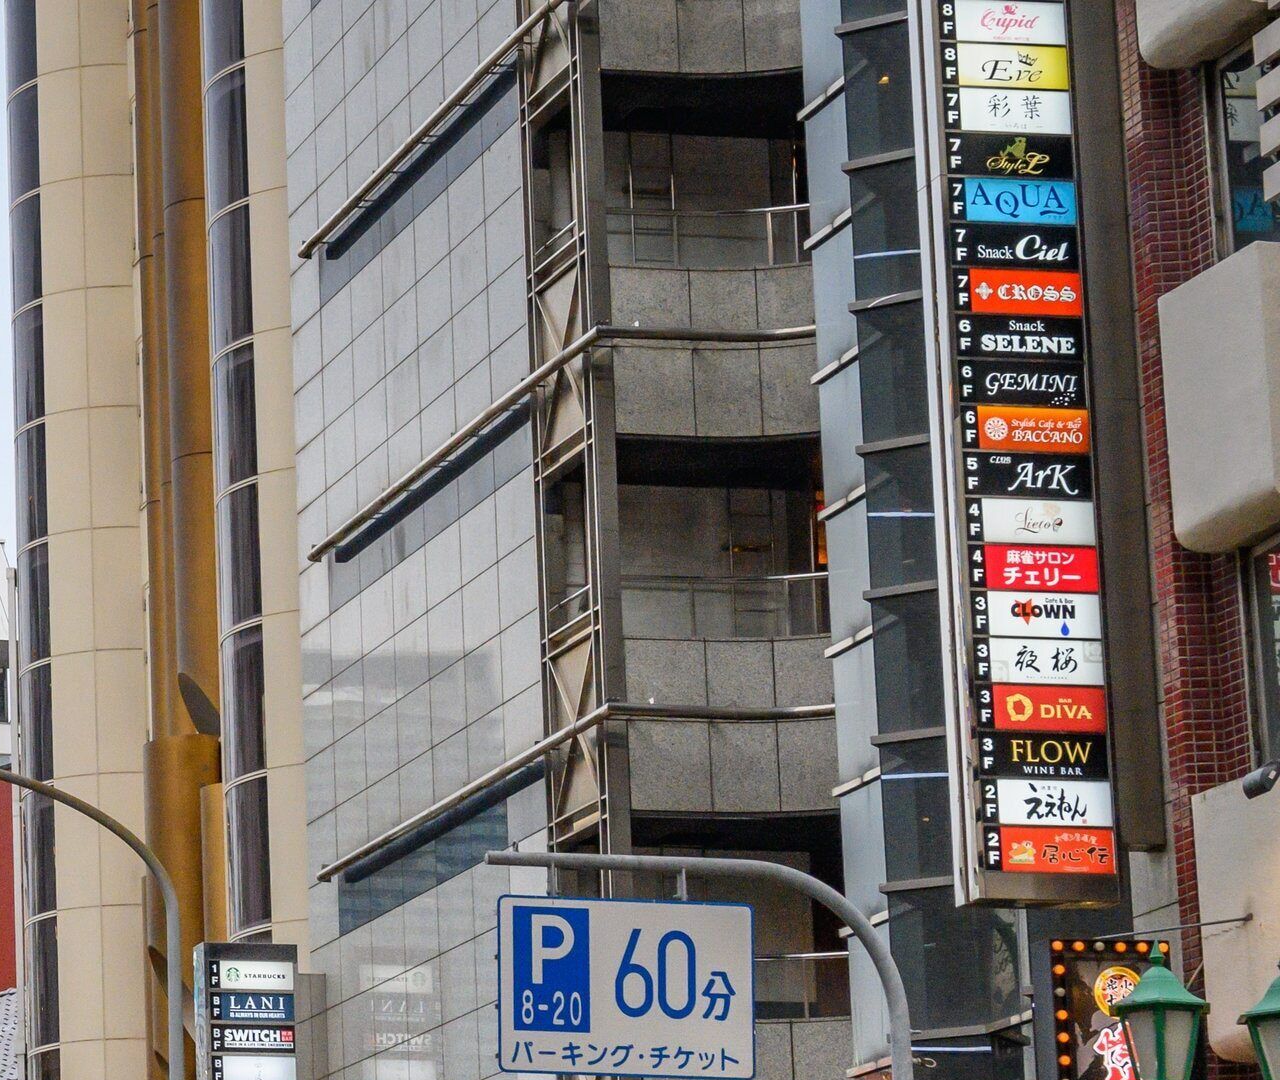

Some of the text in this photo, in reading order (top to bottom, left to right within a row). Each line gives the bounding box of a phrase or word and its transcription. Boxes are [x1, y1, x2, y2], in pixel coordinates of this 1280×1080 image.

[981, 9, 1039, 35] Cupid
[981, 59, 1043, 83] Eve
[988, 94, 1043, 120] 彩葉
[970, 182, 1069, 218] AQUA
[977, 234, 1069, 261] Snack Ciel
[997, 284, 1076, 302] CROSS
[1009, 320, 1045, 332] Snack
[980, 334, 1076, 355] SELENE
[985, 372, 1077, 396] GEMINI
[1038, 419, 1054, 428] Cafe
[1012, 429, 1083, 445] BACCANO
[1007, 462, 1079, 495] ArK
[1006, 549, 1075, 566] 麻雀サロン
[1003, 567, 1081, 587] チェリー
[1010, 603, 1076, 619] CLOWN
[1040, 704, 1092, 720] DIVA
[1010, 739, 1092, 764] FLOW
[1023, 765, 1083, 776] WINE BAR
[531, 913, 575, 984] P
[615, 928, 736, 1021] 60分
[230, 996, 285, 1010] LANI
[522, 989, 582, 1026] 8-20
[224, 1029, 281, 1042] SWITCH
[512, 1041, 739, 1071] パーキング・チケット
